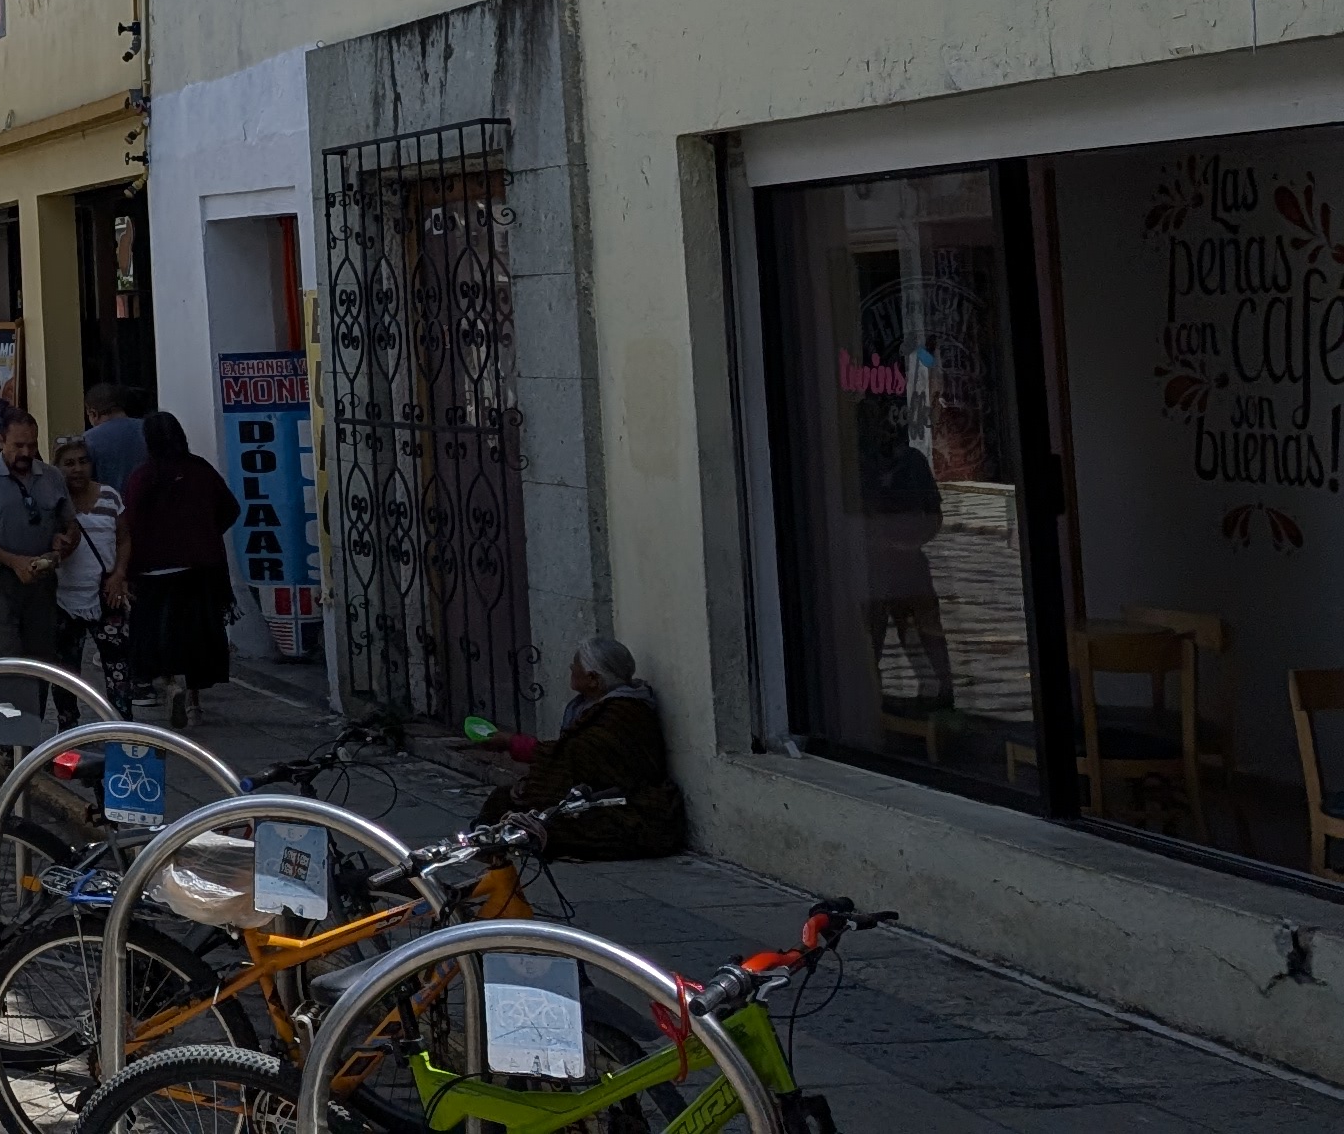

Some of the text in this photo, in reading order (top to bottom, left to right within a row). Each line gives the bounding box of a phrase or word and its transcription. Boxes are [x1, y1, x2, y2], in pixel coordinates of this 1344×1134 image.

[1202, 154, 1258, 234] Las
[1176, 322, 1220, 357] con
[220, 359, 291, 377] EXCHANGE
[838, 347, 907, 396] twins
[223, 375, 310, 406] MONE
[1231, 394, 1277, 430] son
